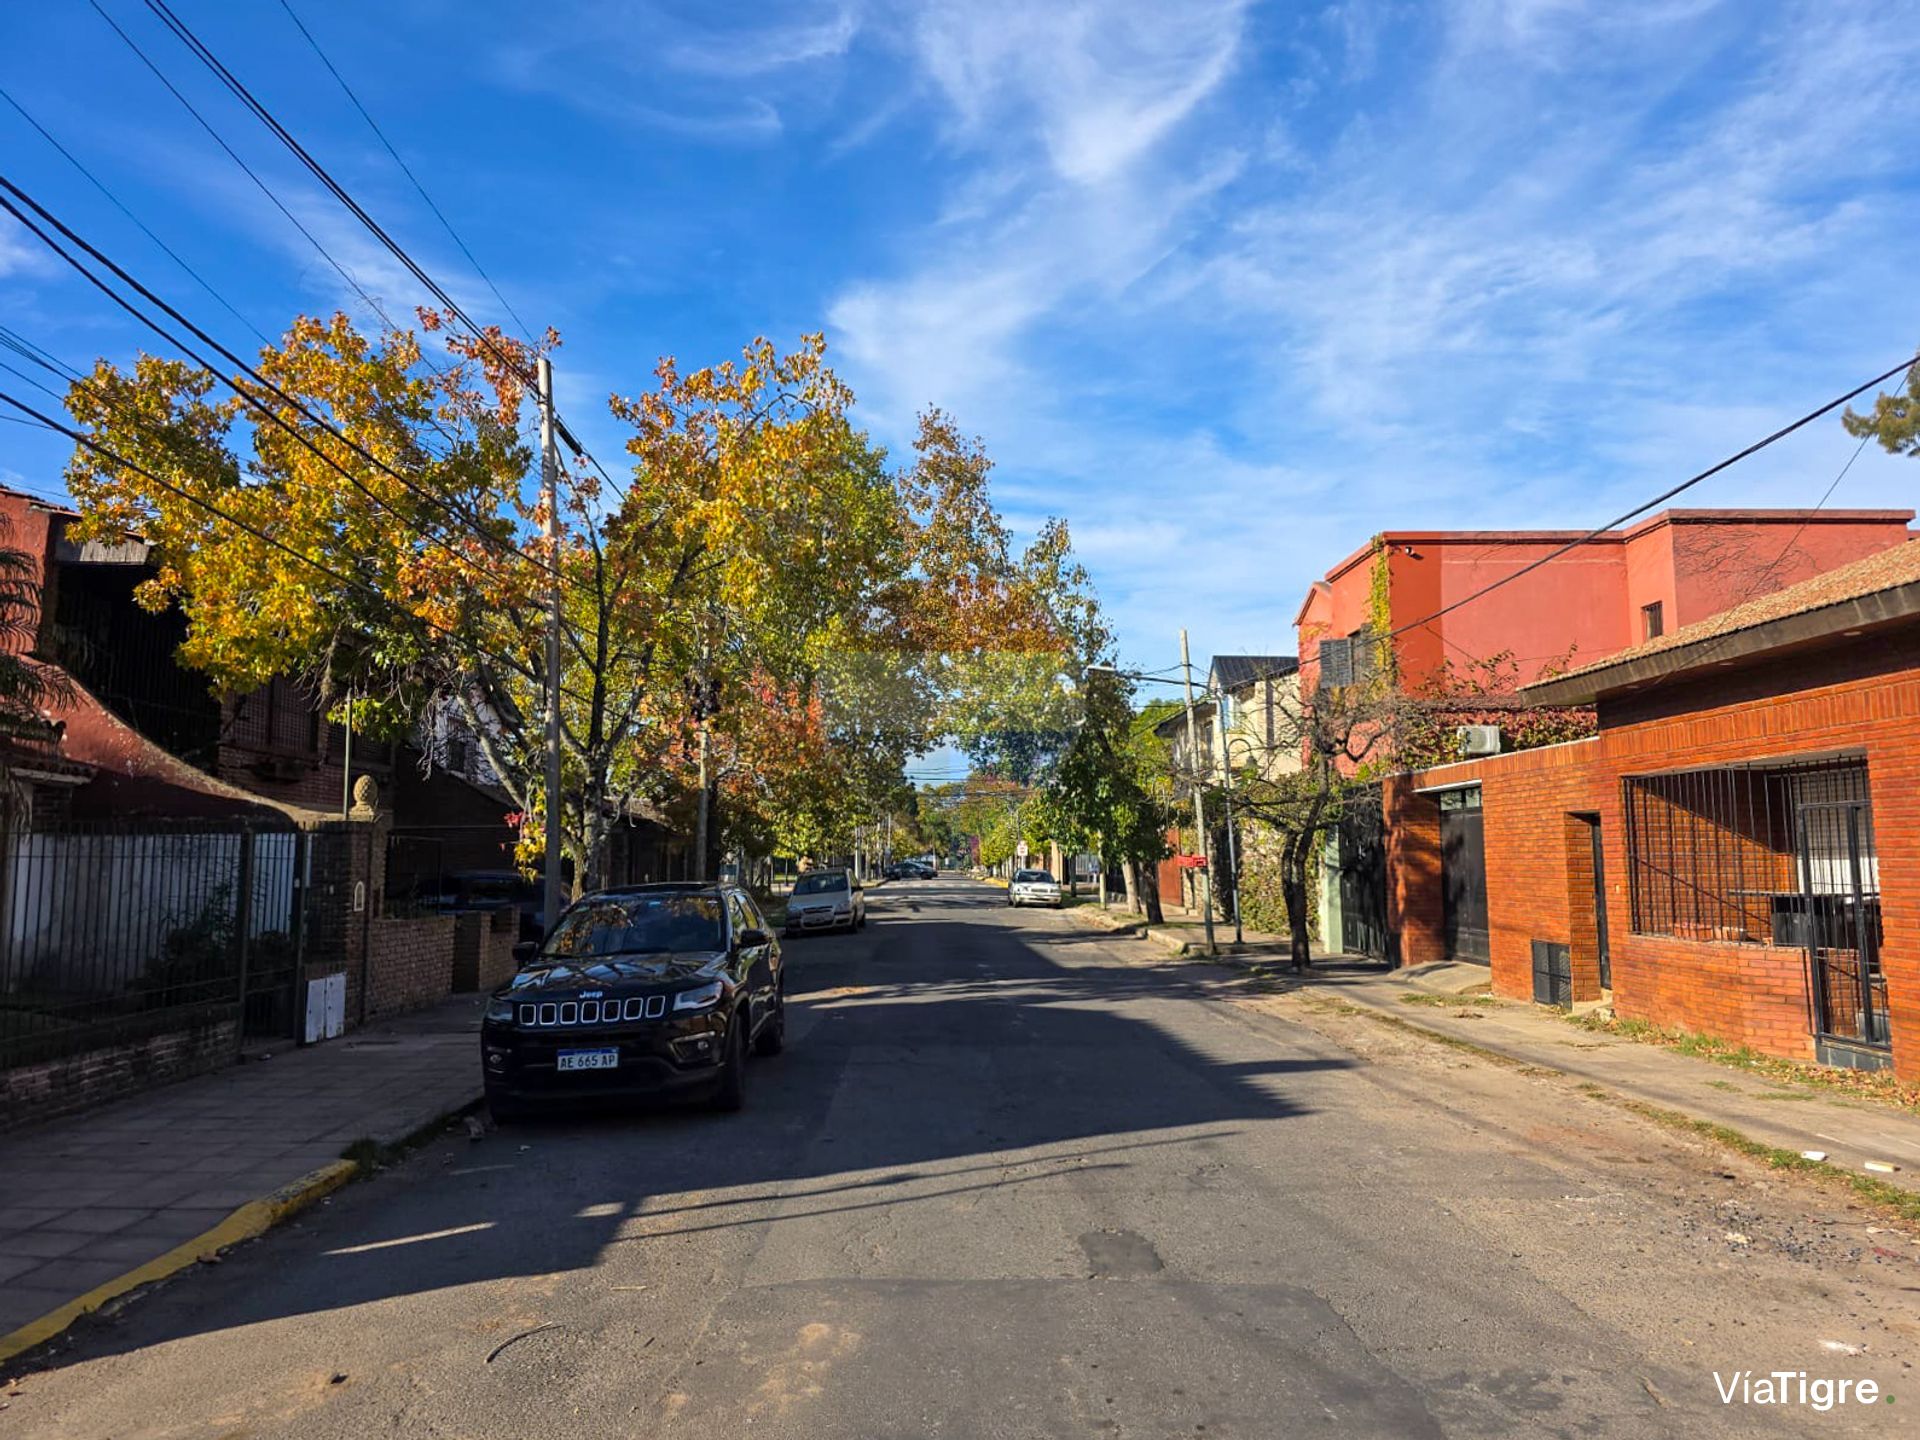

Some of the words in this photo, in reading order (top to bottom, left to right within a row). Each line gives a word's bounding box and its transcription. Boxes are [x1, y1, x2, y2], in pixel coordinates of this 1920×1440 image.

[579, 990, 603, 998] Jeep
[560, 1056, 574, 1069] AE
[577, 1055, 598, 1068] 665
[601, 1054, 615, 1067] AP
